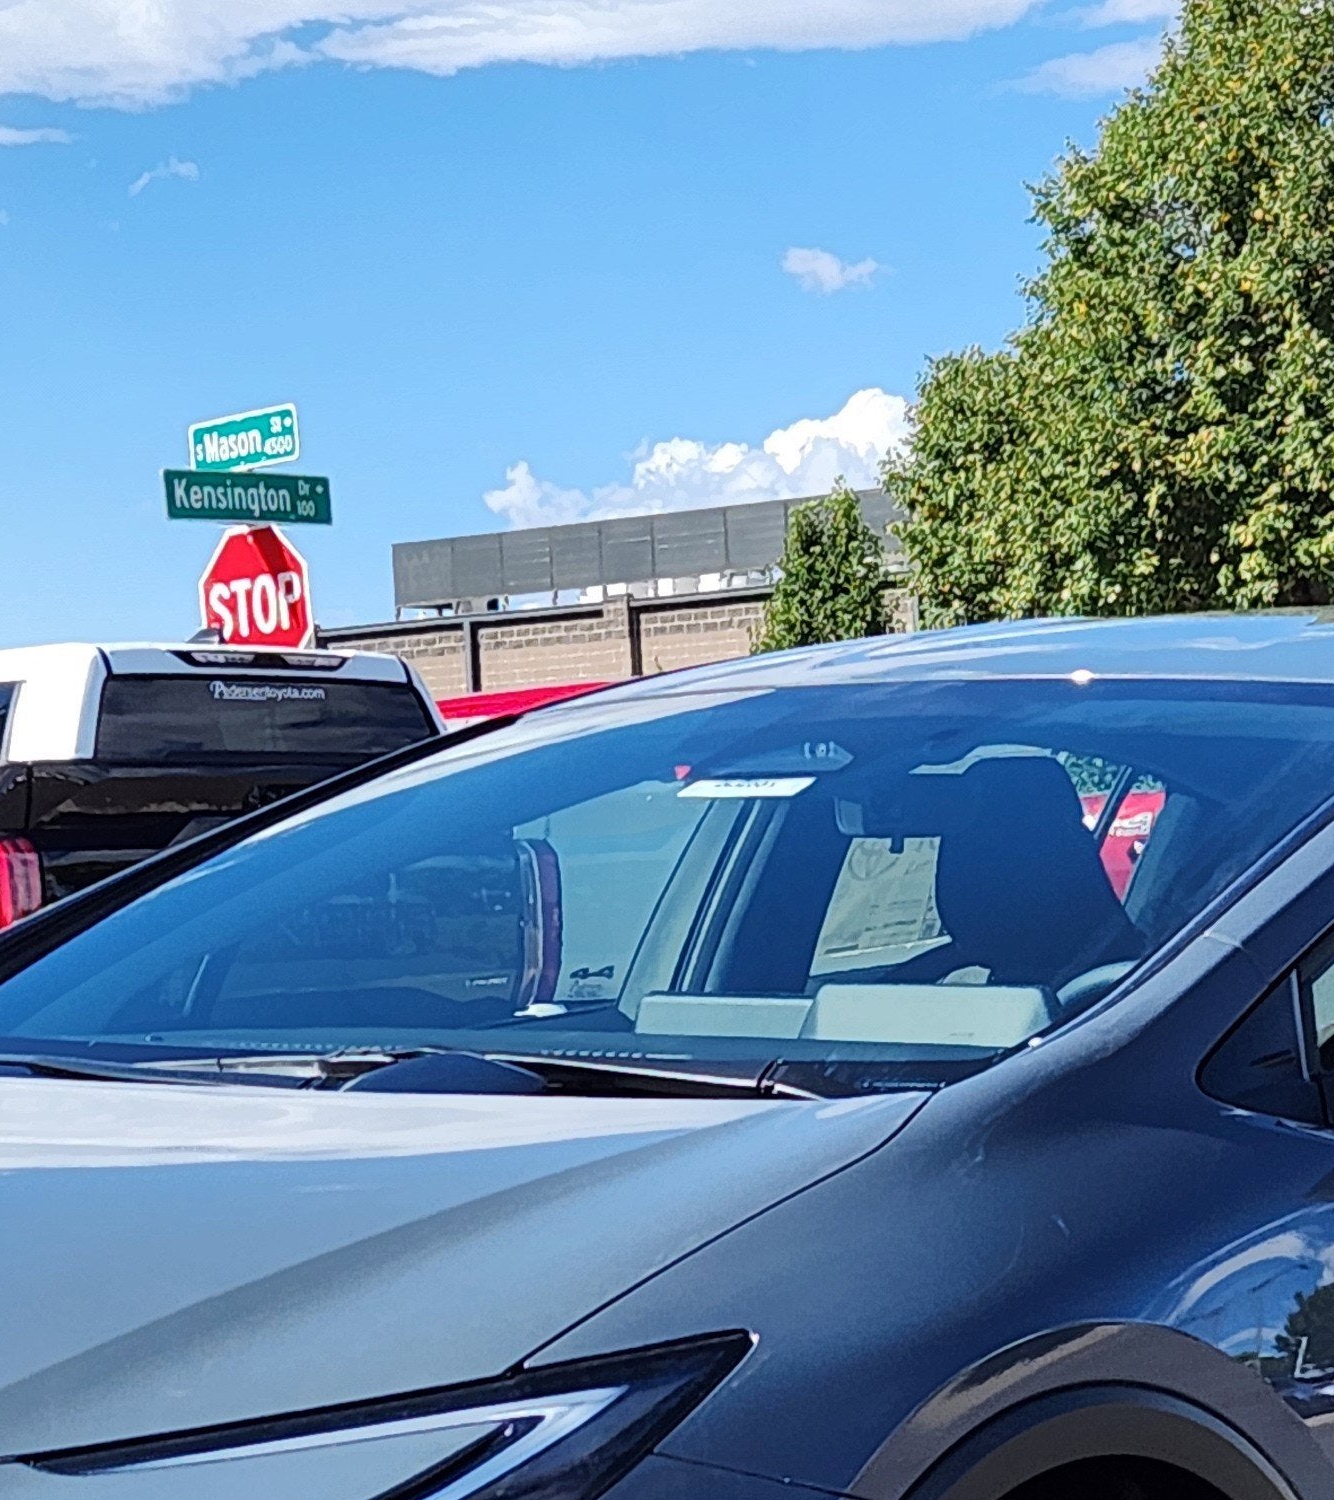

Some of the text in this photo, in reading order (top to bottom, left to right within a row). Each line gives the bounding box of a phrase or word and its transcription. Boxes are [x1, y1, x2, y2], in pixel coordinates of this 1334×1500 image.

[196, 444, 204, 461] S
[203, 429, 263, 463] Mason
[173, 478, 311, 517] Kensington Dr
[297, 500, 316, 516] 100
[209, 571, 302, 641] STOP
